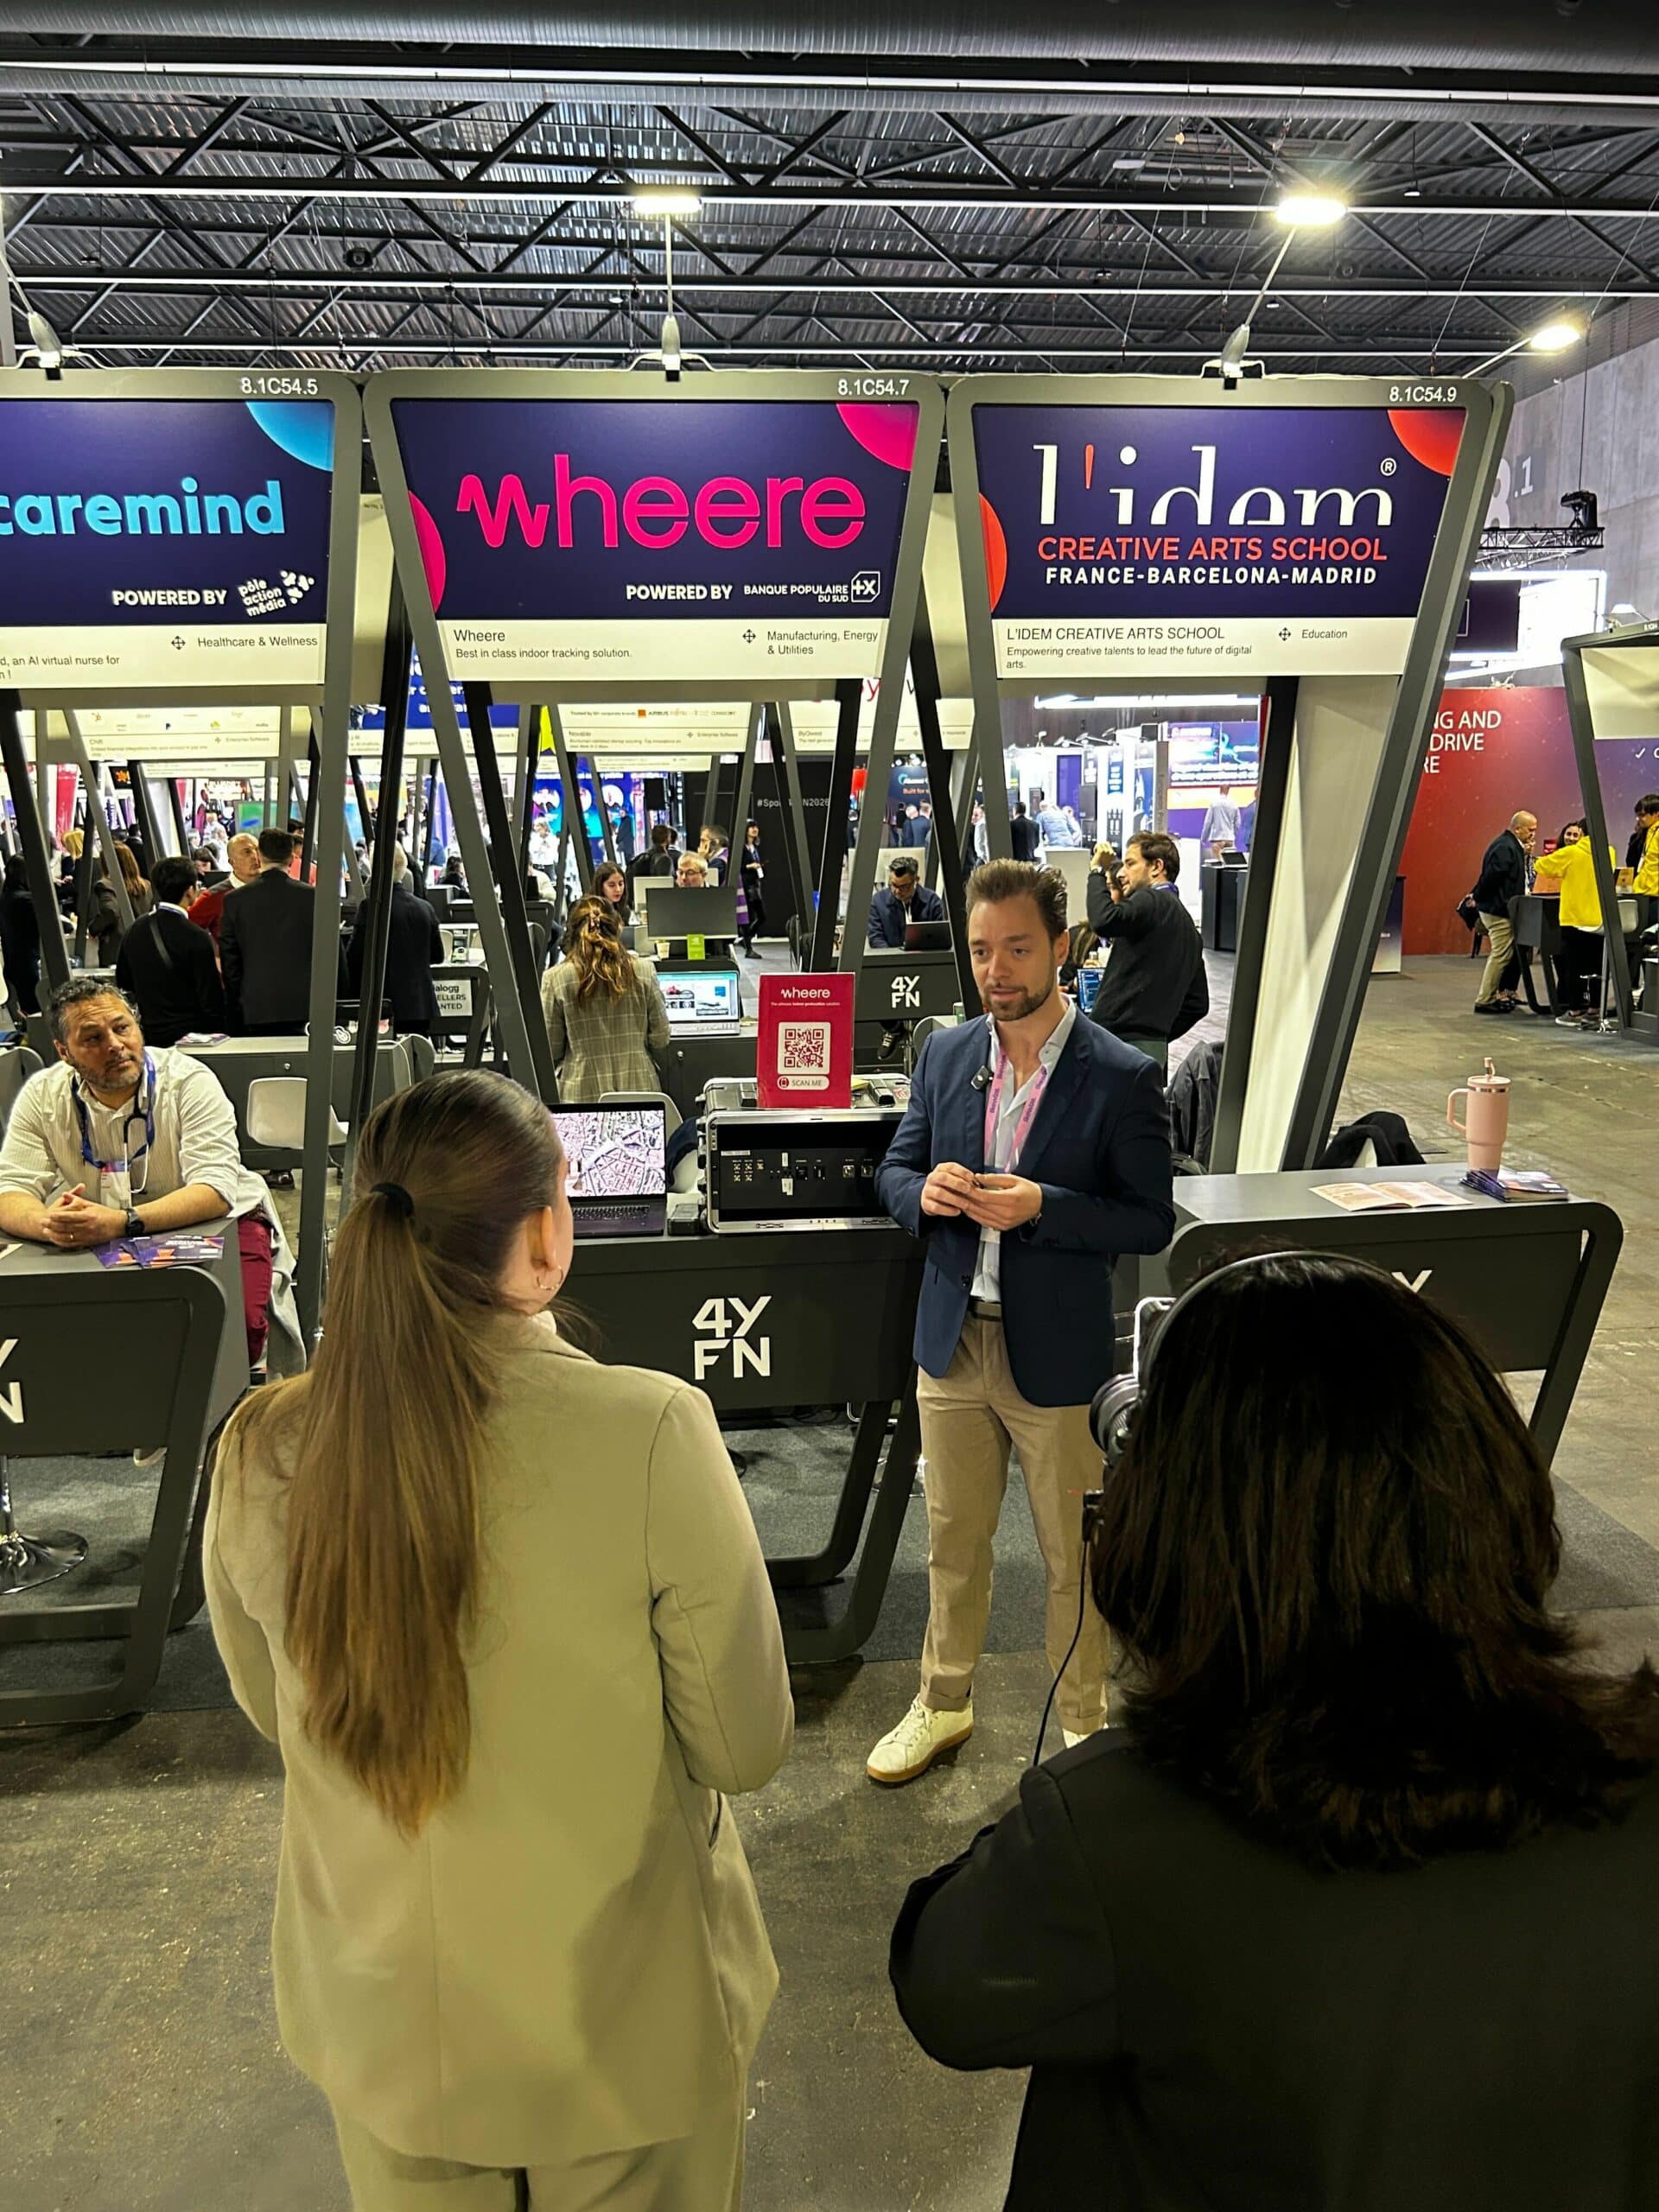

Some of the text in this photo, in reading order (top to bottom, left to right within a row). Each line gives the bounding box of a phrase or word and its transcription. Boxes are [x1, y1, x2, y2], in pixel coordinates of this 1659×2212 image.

[240, 378, 319, 395] 8.1C54.5
[837, 378, 910, 396] 8.1C54.7
[1389, 385, 1458, 403] 8.1C54.9
[457, 454, 866, 549] wheere
[1038, 537, 1388, 561] CREATIVE ARTS SCHOOL
[1046, 566, 1377, 585] FRANCE-BARCELONA-MADRID
[111, 589, 227, 606] POWERED BY
[242, 587, 283, 607] action
[626, 584, 733, 600] POWERED BY
[744, 585, 849, 595] BANQUE POPULAIRE
[198, 634, 318, 648] Healthcare & Wellness
[454, 629, 505, 642] Wheere
[767, 630, 879, 643] Manufacturing, Energy
[1007, 626, 1225, 640] L'IDEM CREATIVE ARTS SCHOOL
[1301, 629, 1348, 639] Education
[456, 648, 632, 660] Best in class indoor tracking solution.
[767, 645, 814, 655] & Utilities
[1007, 645, 1252, 658] Empowering creative talents to lead the future of digital
[29, 656, 40, 665] AI
[41, 655, 73, 665] virtual
[75, 657, 104, 665] nurse
[106, 655, 120, 664] for
[1006, 659, 1027, 670] arts.
[1458, 709, 1502, 729] AND
[1429, 732, 1485, 753] DRIVE
[891, 975, 920, 992] 4Y
[780, 987, 831, 999] wheere
[891, 991, 920, 1008] FN
[692, 1295, 772, 1338] 4Y
[693, 1337, 771, 1381] FN
